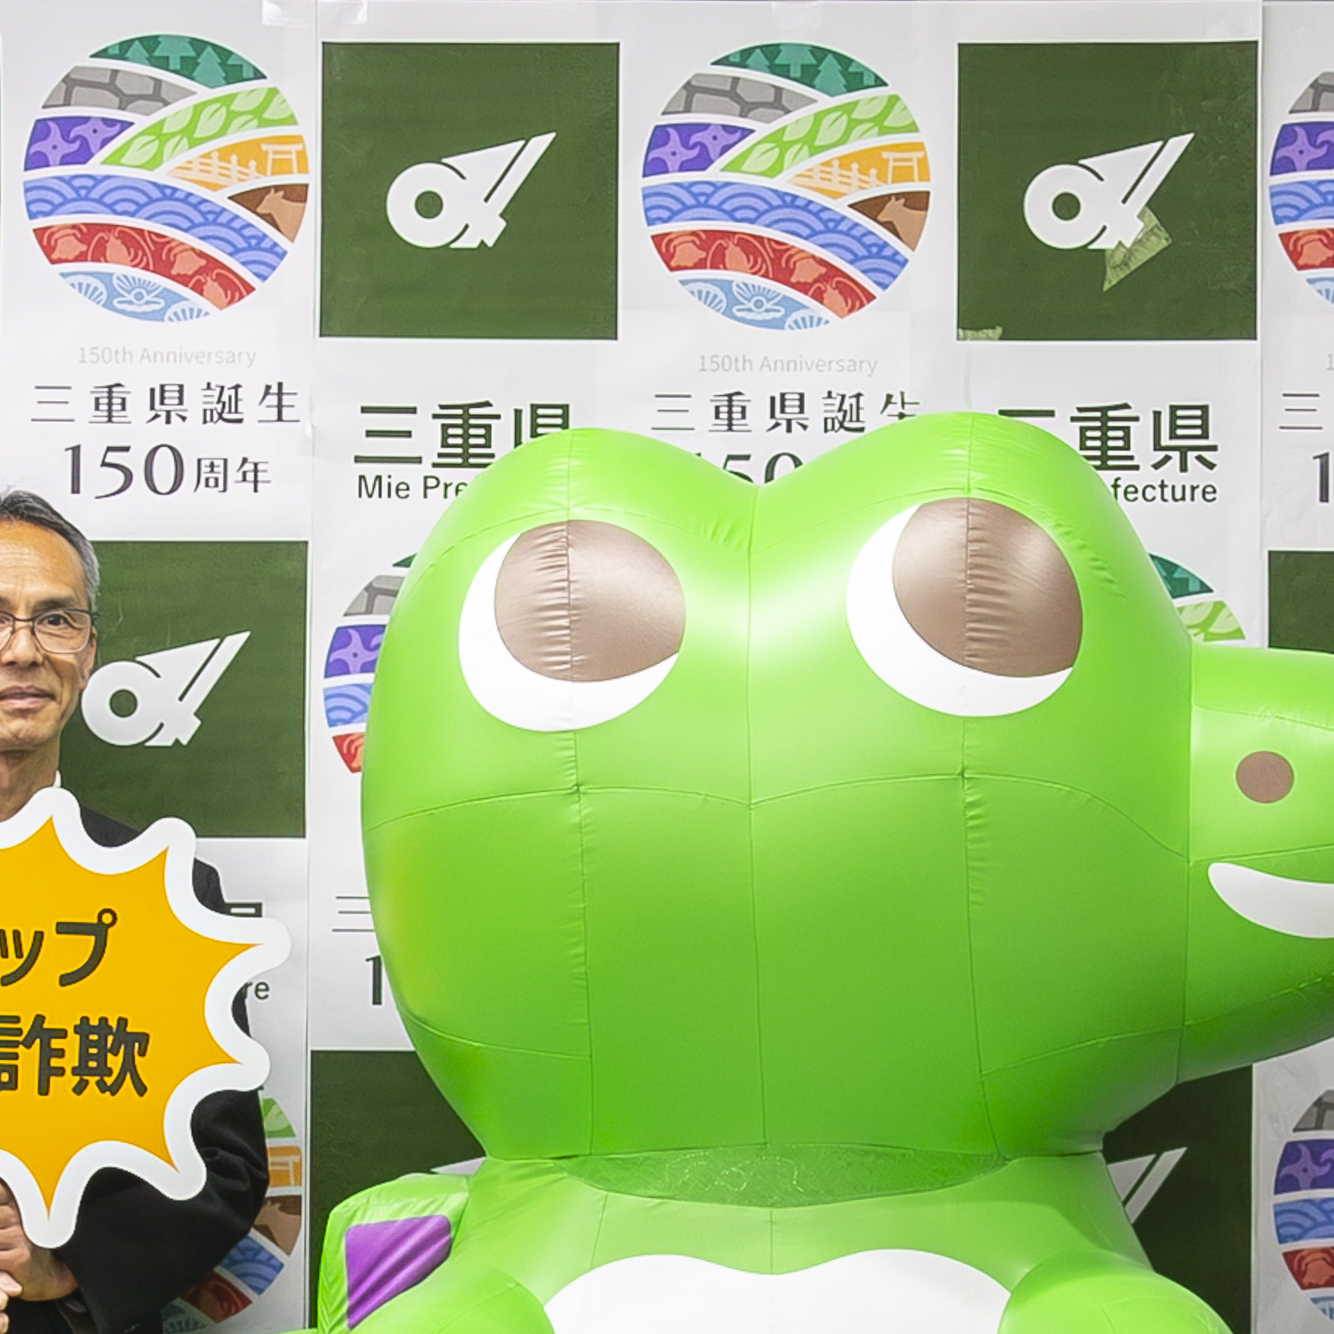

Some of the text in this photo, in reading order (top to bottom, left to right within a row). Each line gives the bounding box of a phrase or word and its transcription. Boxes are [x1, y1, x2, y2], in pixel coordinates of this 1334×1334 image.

[79, 347, 256, 368] 150th Anniversary
[699, 355, 877, 377] 150th Anniversary
[32, 382, 299, 424] 三重県誕生
[651, 389, 920, 433] 三重県誕生
[65, 444, 267, 499] 150周年
[359, 475, 410, 499] Mie
[1111, 477, 1218, 503] fecture
